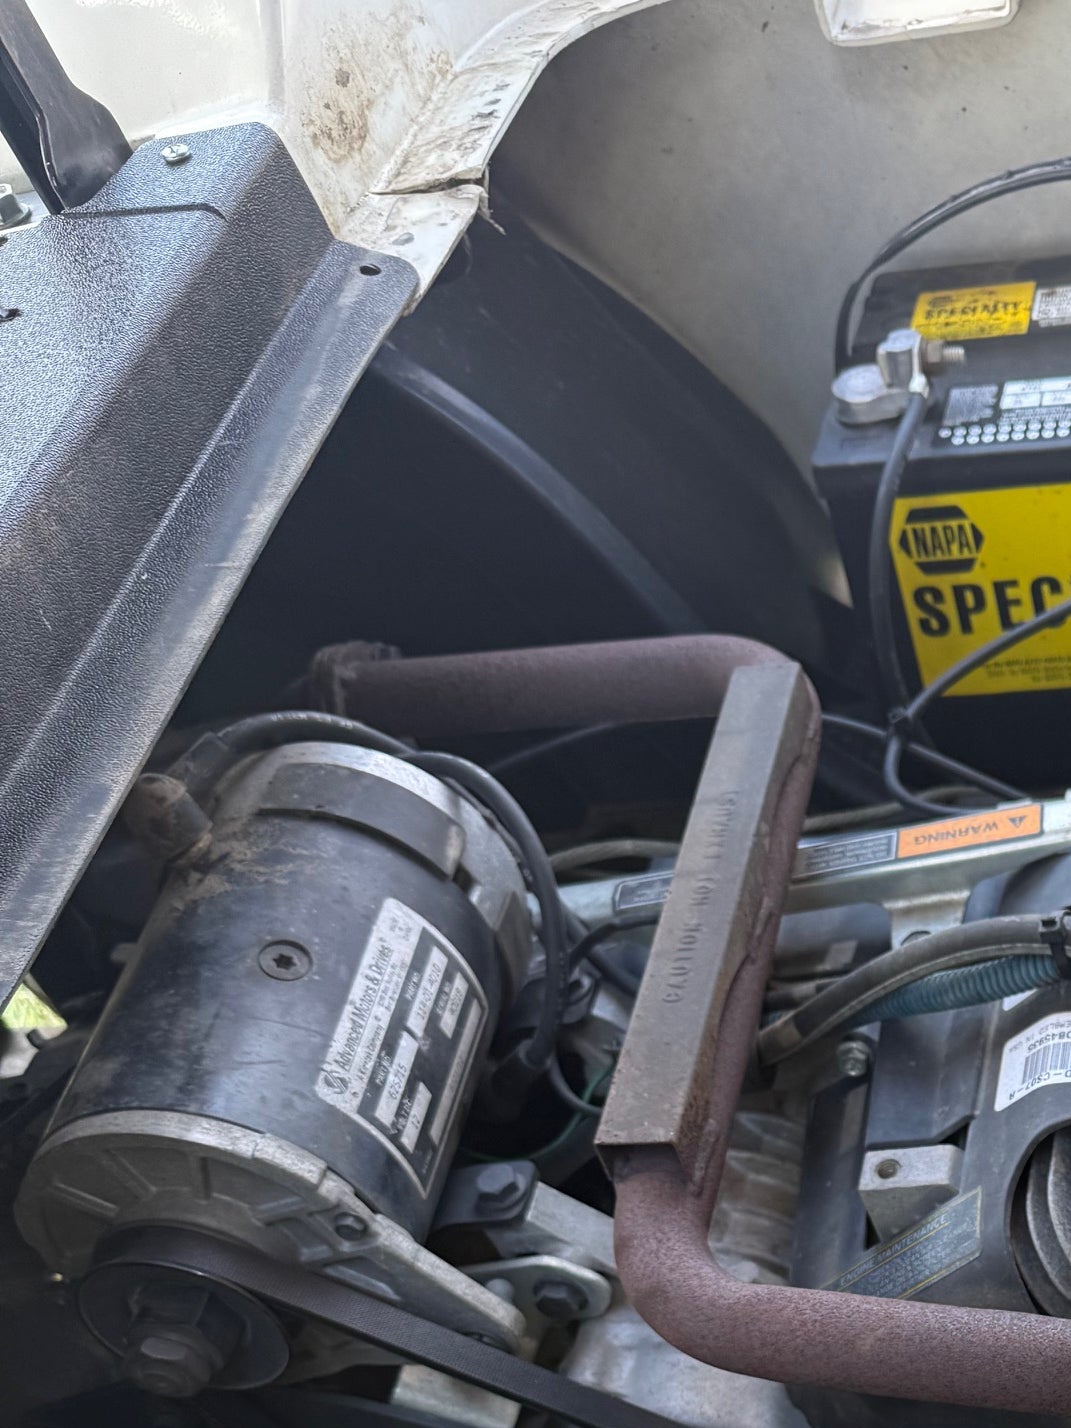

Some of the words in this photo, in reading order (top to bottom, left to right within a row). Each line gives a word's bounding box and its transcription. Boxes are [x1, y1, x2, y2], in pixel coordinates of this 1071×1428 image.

[912, 524, 970, 559] NAPA
[911, 818, 1001, 848] WARNING
[363, 971, 380, 985] &
[351, 983, 377, 1021] Motors
[333, 1017, 364, 1071] Advanced
